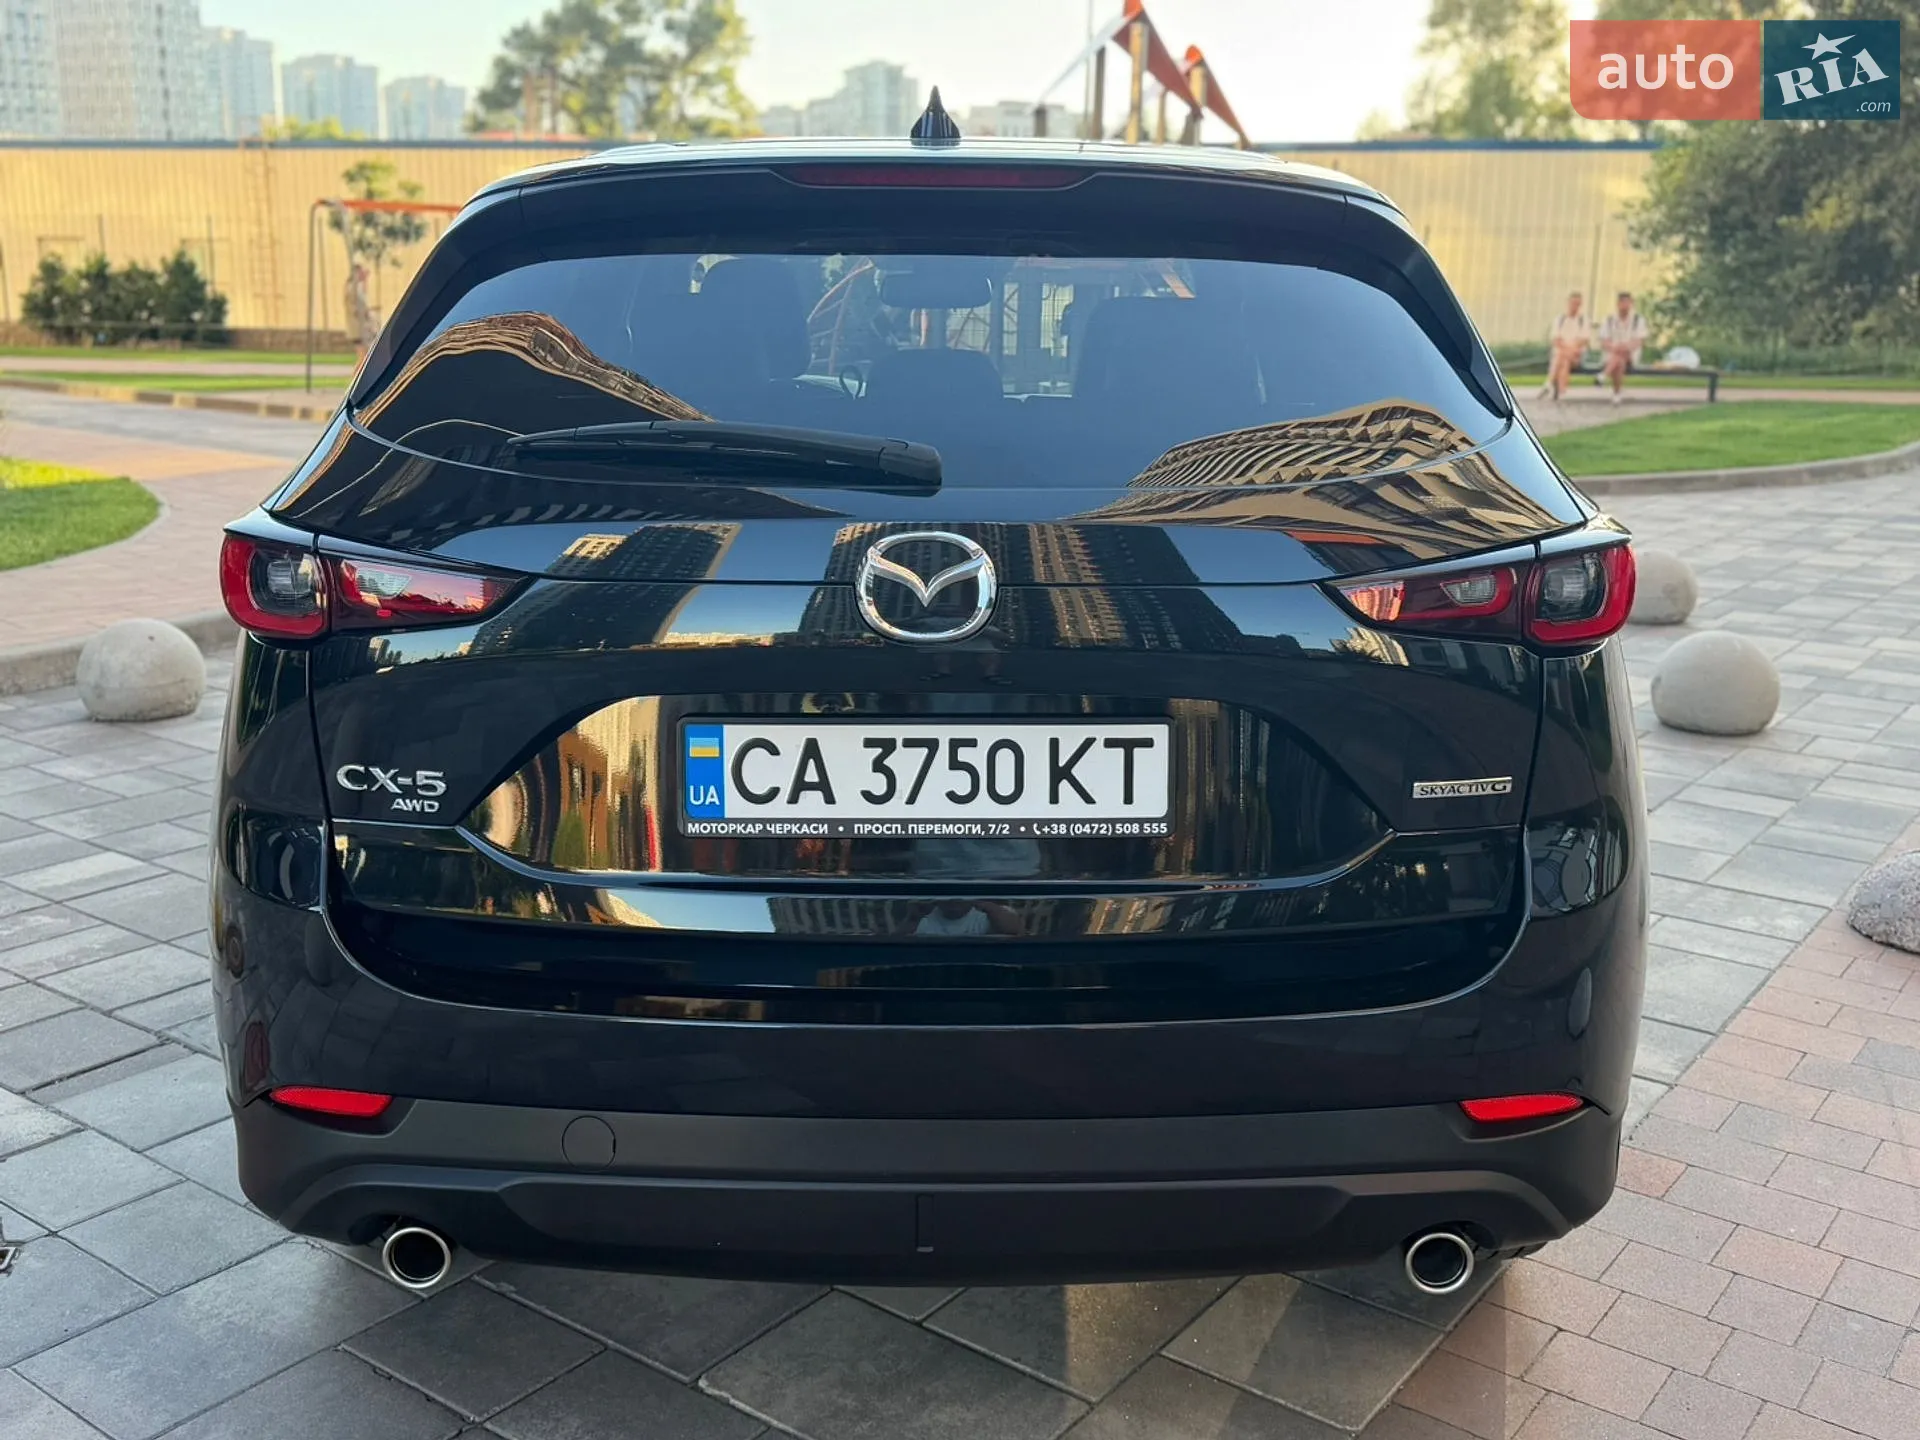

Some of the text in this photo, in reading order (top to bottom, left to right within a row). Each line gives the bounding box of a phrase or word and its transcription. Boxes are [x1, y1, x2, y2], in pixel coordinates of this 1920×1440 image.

[336, 764, 447, 797] CX-5
[731, 737, 1155, 806] CA 3750 KT
[390, 798, 440, 813] AWD
[689, 786, 720, 806] UA
[687, 823, 1168, 836] МОТОРКАР ЧЕРКАСИ ПРОСП. ПЕРЕМОГИ, 7/2 +38 (0472) 508 555
